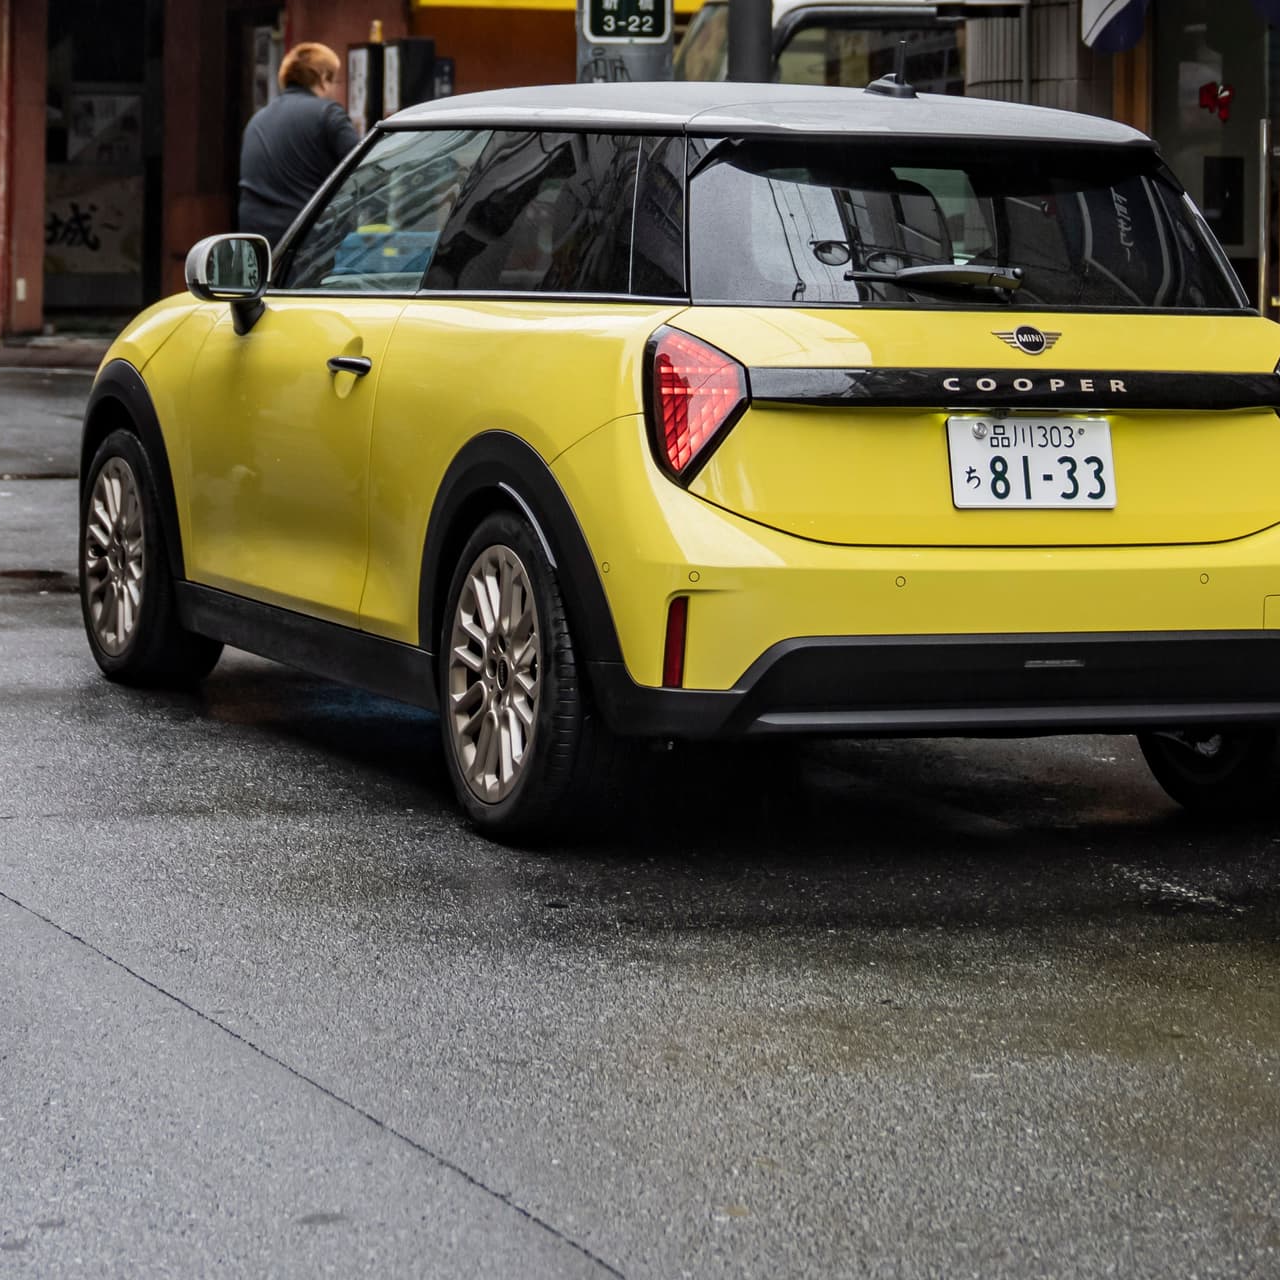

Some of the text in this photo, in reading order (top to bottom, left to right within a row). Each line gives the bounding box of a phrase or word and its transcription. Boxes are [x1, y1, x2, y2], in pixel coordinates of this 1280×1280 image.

[603, 15, 653, 32] 3-22
[1017, 331, 1043, 344] MINI
[943, 378, 1127, 393] COOPER
[965, 466, 981, 489] ち
[989, 456, 1106, 500] 81-33
